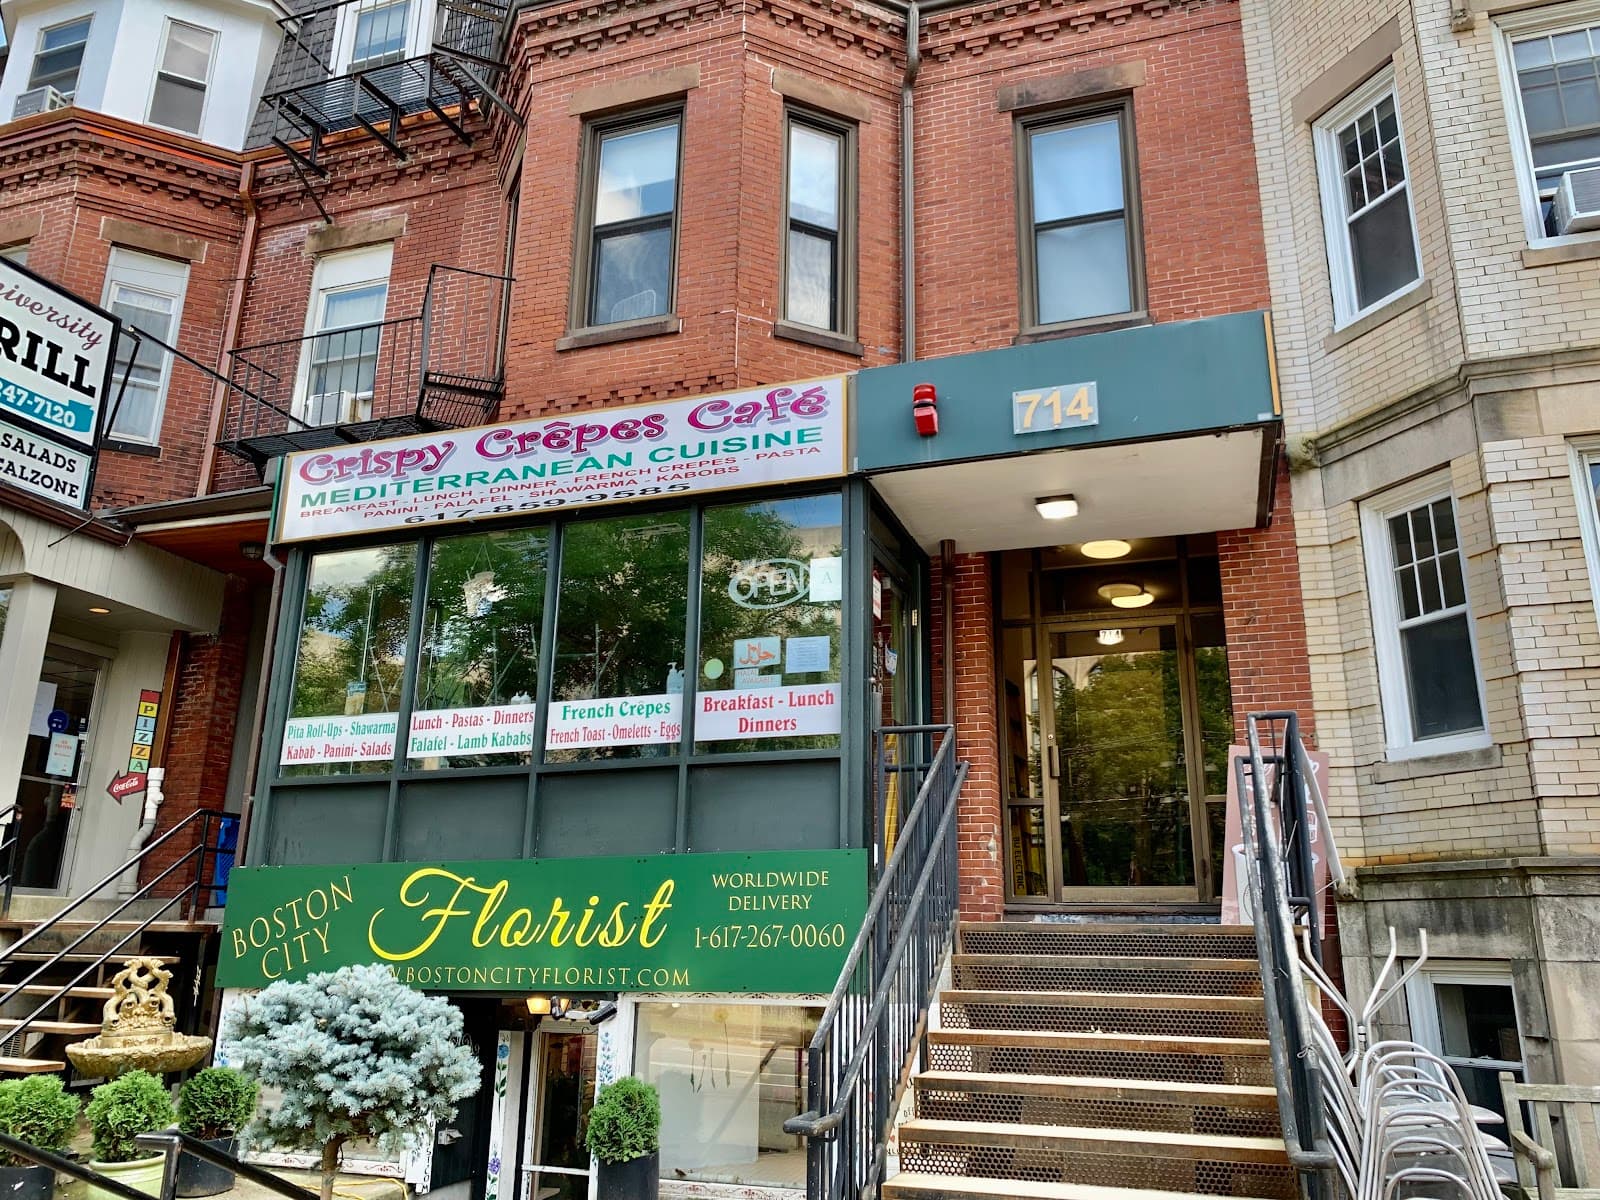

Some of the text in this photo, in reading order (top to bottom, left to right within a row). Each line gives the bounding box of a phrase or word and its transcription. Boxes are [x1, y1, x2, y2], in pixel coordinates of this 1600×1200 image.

[0, 281, 103, 351] iversity
[0, 382, 76, 428] 47-7120
[1016, 386, 1094, 428] 714
[1, 433, 77, 473] SALADS
[299, 386, 826, 485] Crispy Crêpes Café
[300, 427, 823, 508] MEDITERRANEAN CUISINE
[300, 499, 397, 518] BREAKFAST
[413, 490, 473, 504] LUNCH
[489, 480, 557, 494] DINNER
[574, 467, 651, 484] FRENCH
[658, 456, 737, 473] CREPES
[756, 446, 820, 461] PASTA
[363, 506, 418, 518] PANINI
[435, 495, 512, 509] FALAFEL
[529, 479, 638, 498] SHAWARMA
[656, 466, 740, 482] KABOBS
[404, 482, 691, 524] 617-859-9585
[412, 715, 442, 731] Lunch
[452, 713, 484, 728] Pastas
[493, 710, 534, 725] Dinners
[562, 701, 671, 721] French Crêpes
[703, 692, 774, 713] Breakfast
[788, 689, 835, 707] Lunch
[133, 705, 154, 771] PIZZA
[287, 724, 305, 740] Pita
[306, 722, 343, 738] Roll-Ups
[350, 720, 396, 736] Shawarma
[411, 737, 447, 752] Falafel
[457, 734, 488, 750] Lamb
[491, 731, 532, 747] Kababs
[550, 727, 580, 744] French
[582, 725, 606, 741] Toast
[660, 721, 681, 741] Eggs
[738, 716, 797, 734] Dinners
[286, 745, 315, 760] Kabab
[360, 741, 392, 756] Salads
[712, 870, 829, 889] WORLDWIDE
[232, 874, 353, 958] BOSTON
[368, 867, 675, 961] Florist
[728, 894, 812, 911] DELIVERY
[261, 922, 331, 979] CITY
[694, 923, 845, 948] 1-617-267-0060
